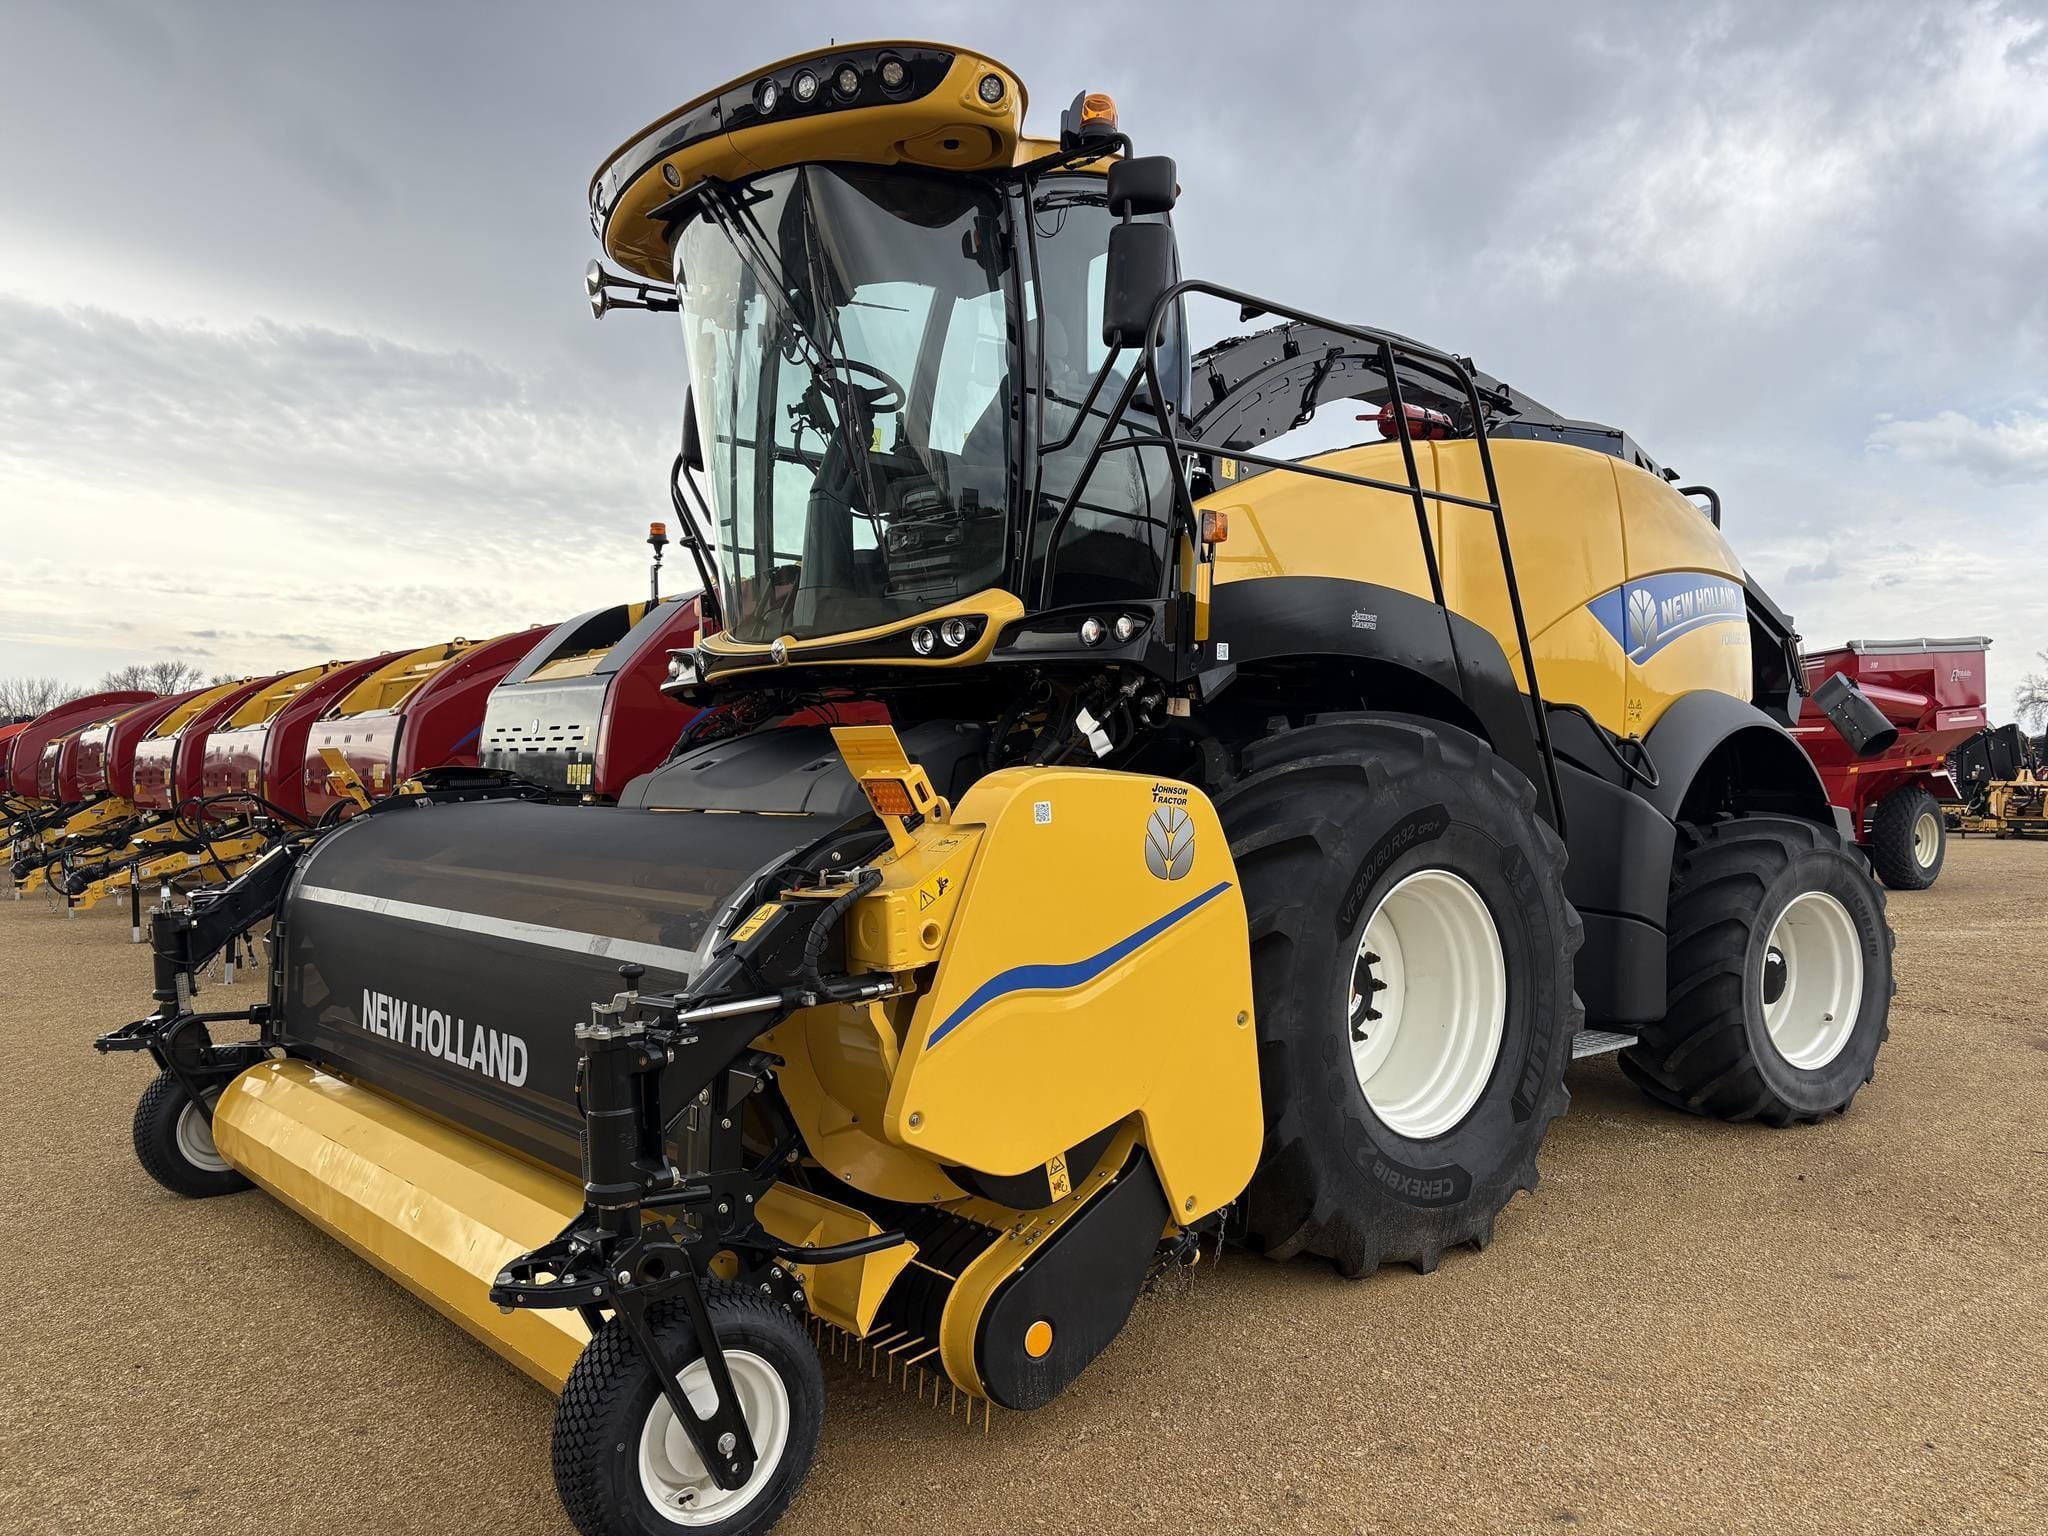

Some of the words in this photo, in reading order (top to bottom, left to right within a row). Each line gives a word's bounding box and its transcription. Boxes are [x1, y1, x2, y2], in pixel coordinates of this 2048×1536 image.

[1661, 591, 1694, 626] NEW
[1695, 586, 1737, 613] HOLLAND
[1151, 782, 1189, 796] JOHNSON
[1152, 793, 1188, 806] TRACTOR
[362, 988, 408, 1043] NEW
[411, 1003, 528, 1088] HOLLAND
